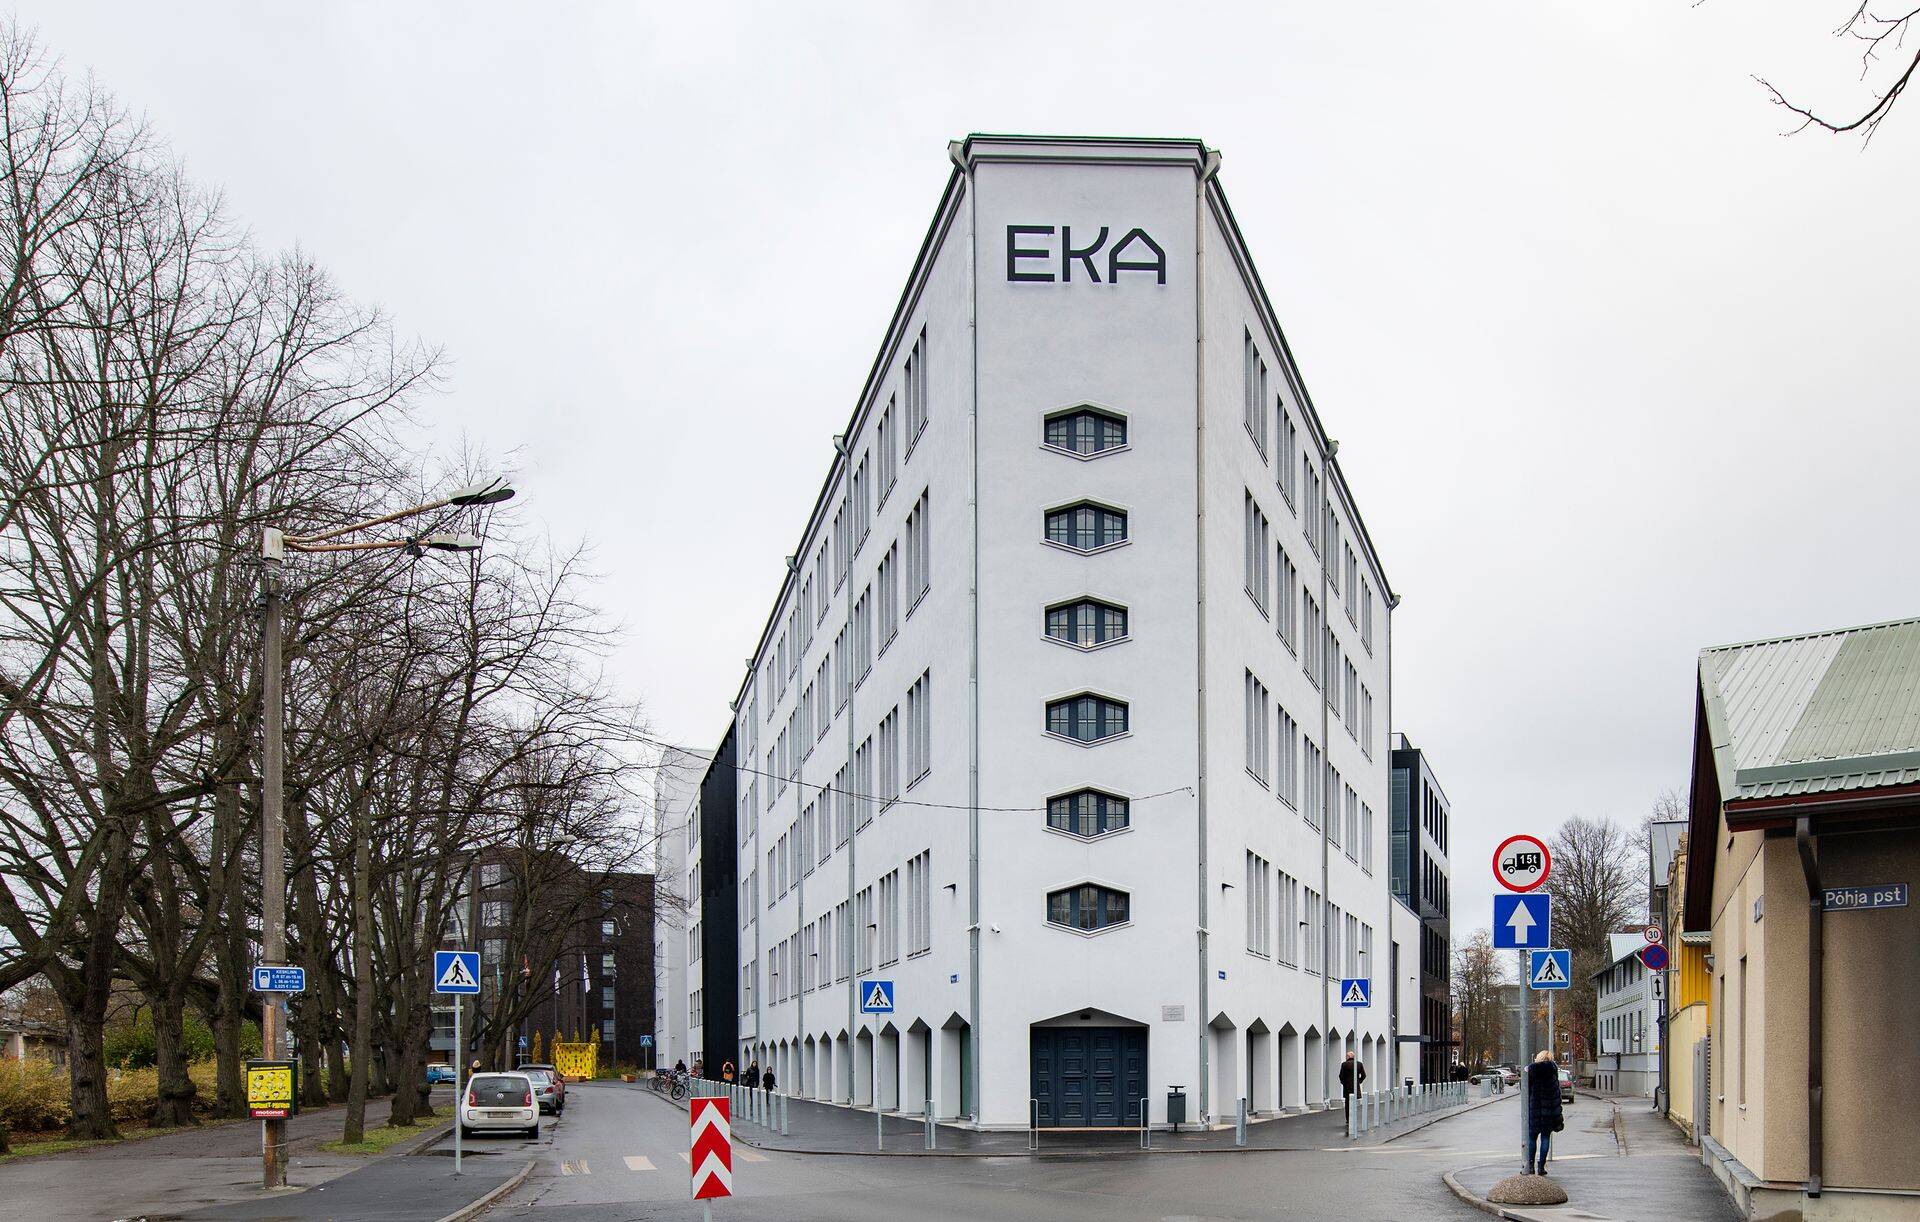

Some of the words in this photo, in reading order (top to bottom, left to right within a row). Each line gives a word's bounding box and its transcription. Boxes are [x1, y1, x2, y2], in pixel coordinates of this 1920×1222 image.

[1006, 224, 1167, 285] EKA
[1519, 854, 1537, 865] 15t
[1825, 890, 1868, 907] Põhja
[1874, 887, 1901, 906] pst
[1648, 930, 1659, 939] 30
